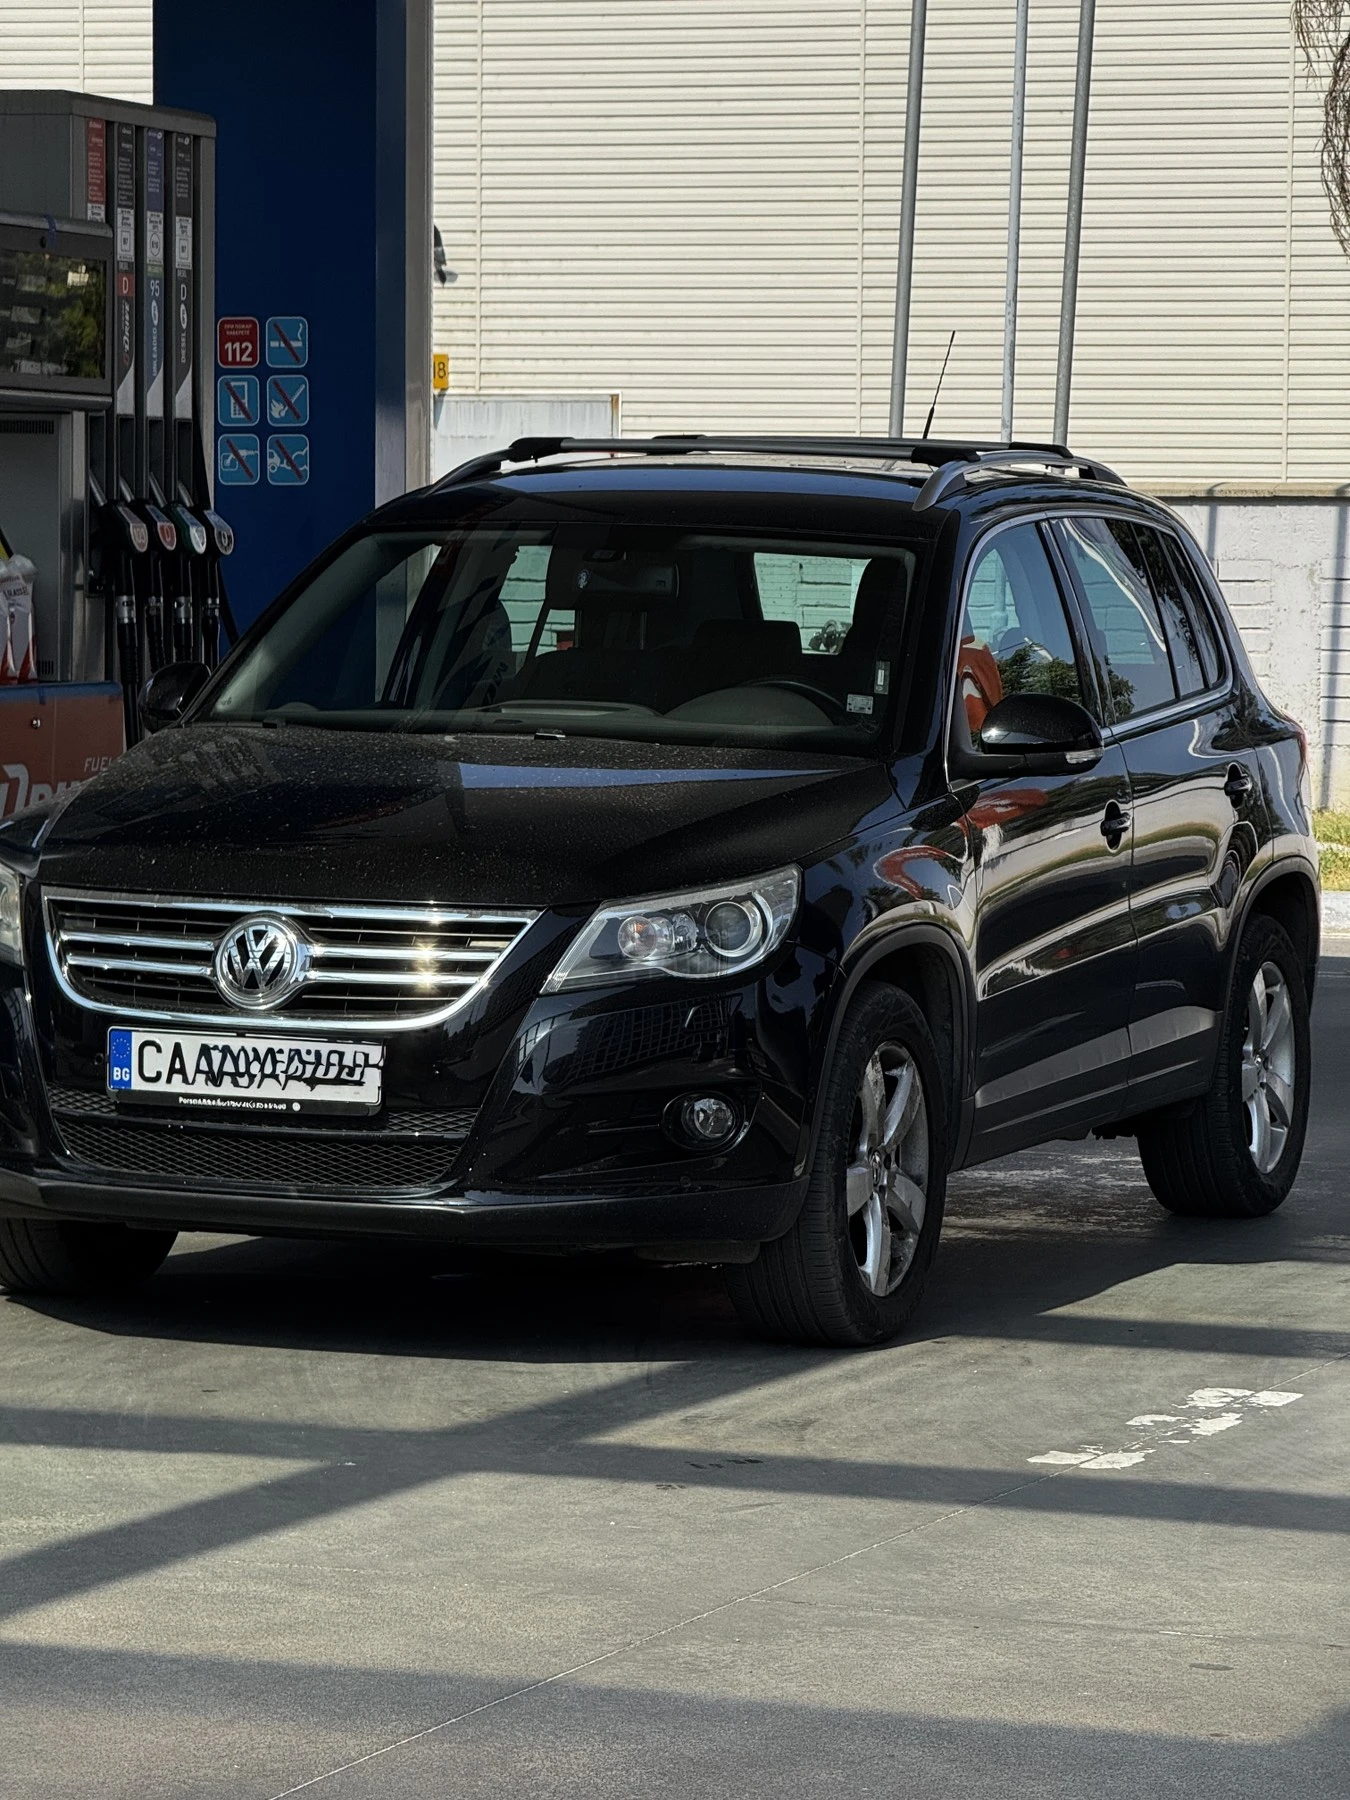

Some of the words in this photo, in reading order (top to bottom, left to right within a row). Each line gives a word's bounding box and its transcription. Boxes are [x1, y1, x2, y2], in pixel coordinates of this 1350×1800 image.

[150, 279, 160, 297] 95
[180, 283, 187, 302] D
[224, 341, 253, 363] 112
[113, 1066, 131, 1082] BG
